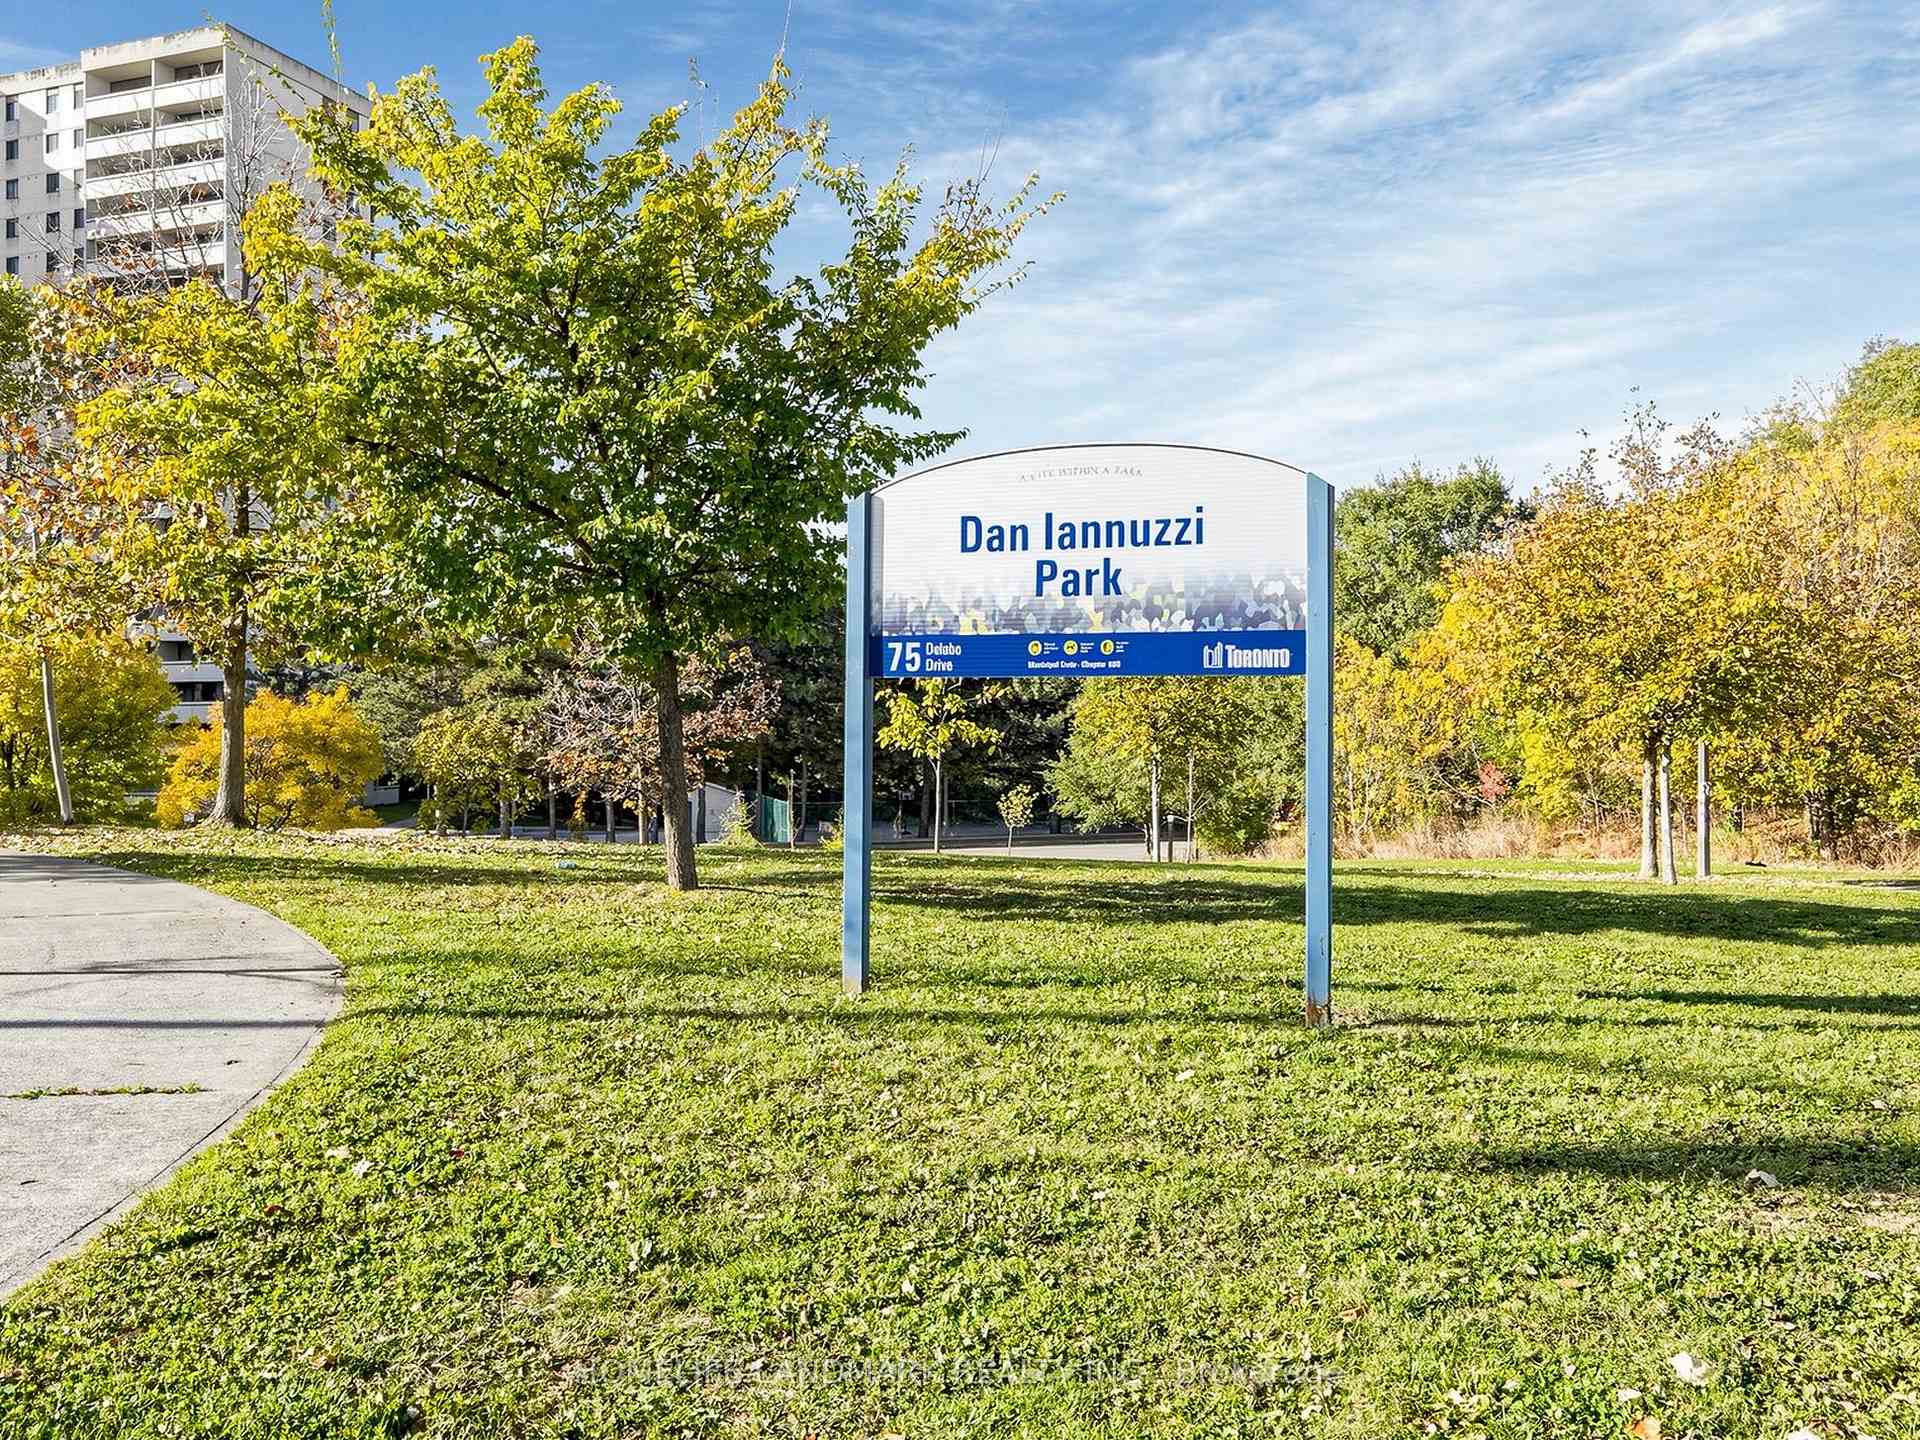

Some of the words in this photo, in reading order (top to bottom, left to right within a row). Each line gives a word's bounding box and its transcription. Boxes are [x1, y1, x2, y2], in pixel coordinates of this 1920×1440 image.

[960, 515, 1029, 553] Dan
[1045, 506, 1204, 550] Iannuzzi
[1035, 557, 1122, 597] Park
[888, 642, 921, 671] 75
[926, 659, 953, 671] Drive
